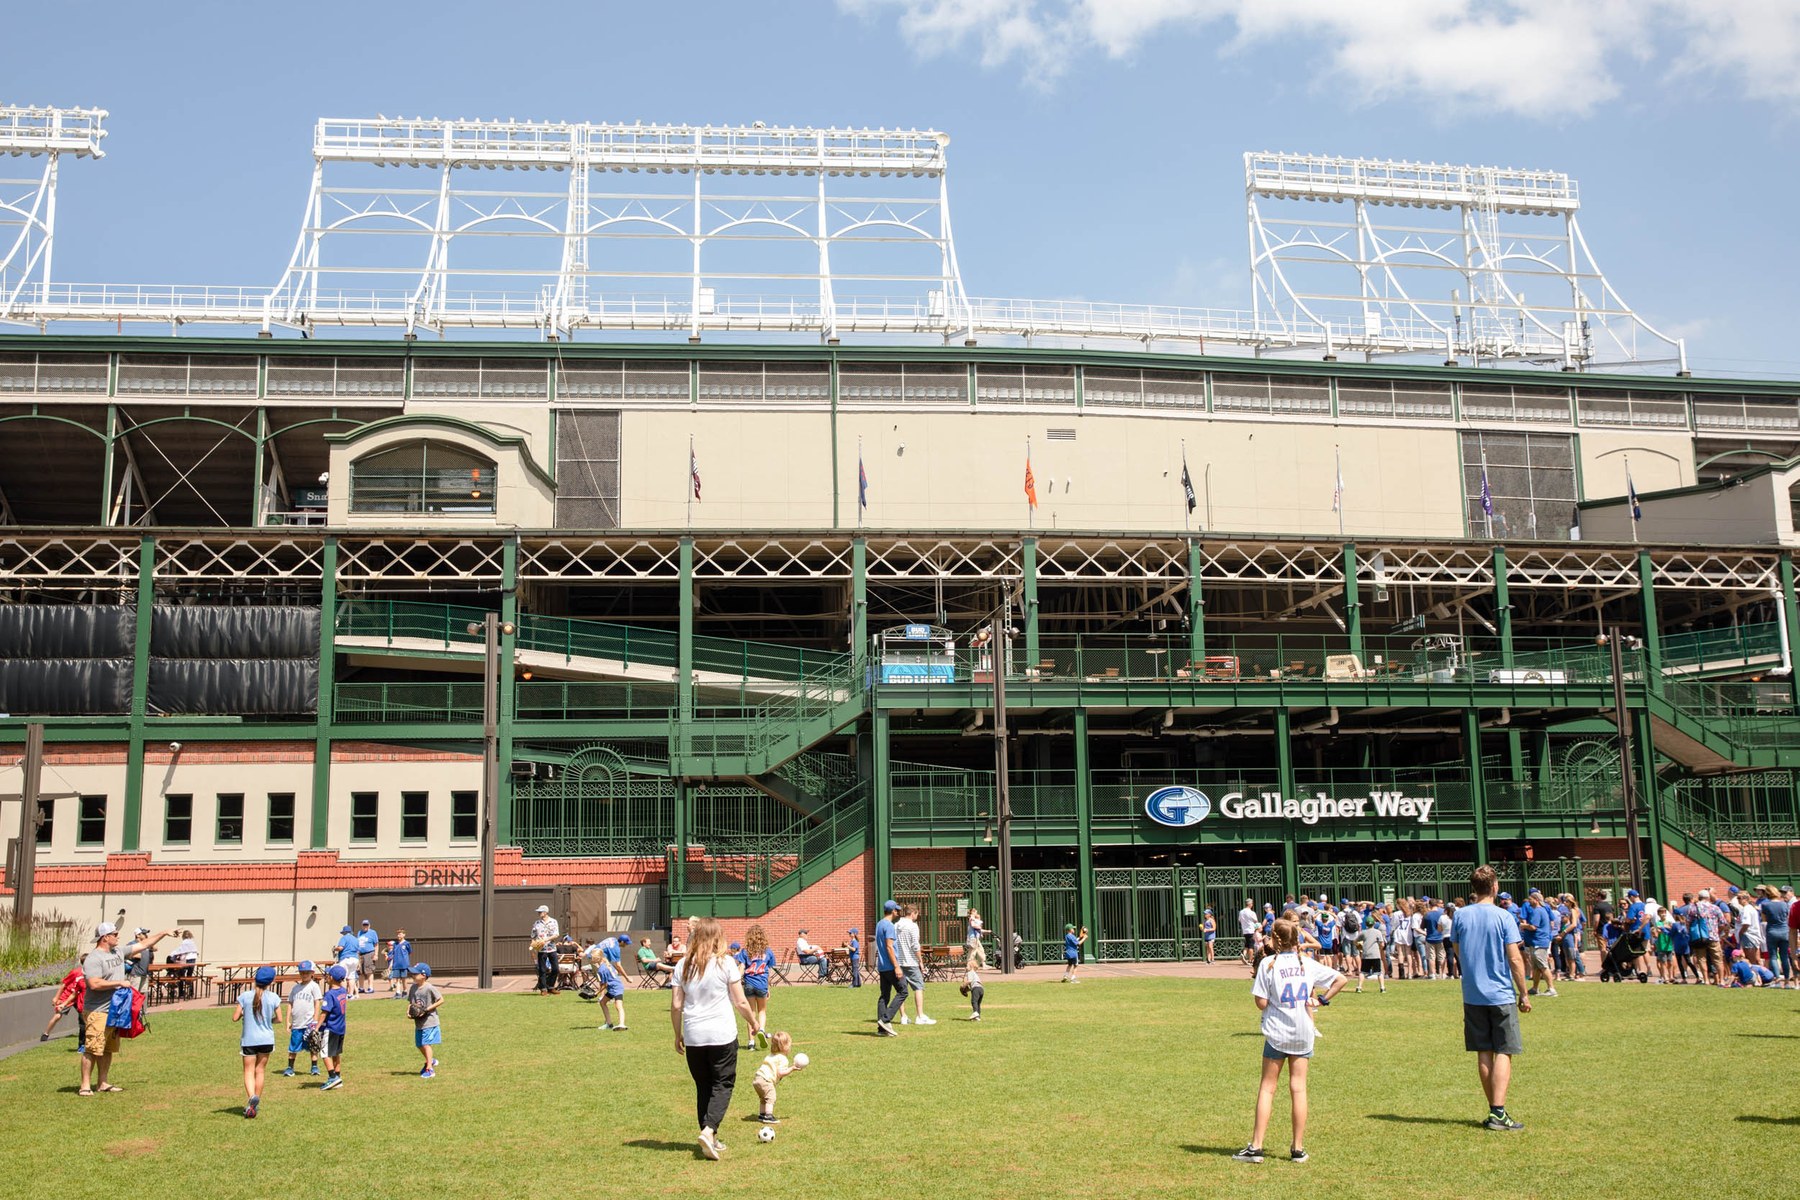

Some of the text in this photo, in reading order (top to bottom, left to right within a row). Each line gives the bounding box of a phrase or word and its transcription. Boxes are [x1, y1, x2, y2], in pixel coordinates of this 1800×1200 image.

[888, 675, 948, 684] BUD LIGHT
[1219, 791, 1367, 825] Gallagher
[1369, 791, 1435, 823] Way
[414, 868, 480, 887] DRINK
[745, 961, 766, 976] 44
[1280, 966, 1306, 979] RIZZO
[1280, 981, 1309, 1009] 44
